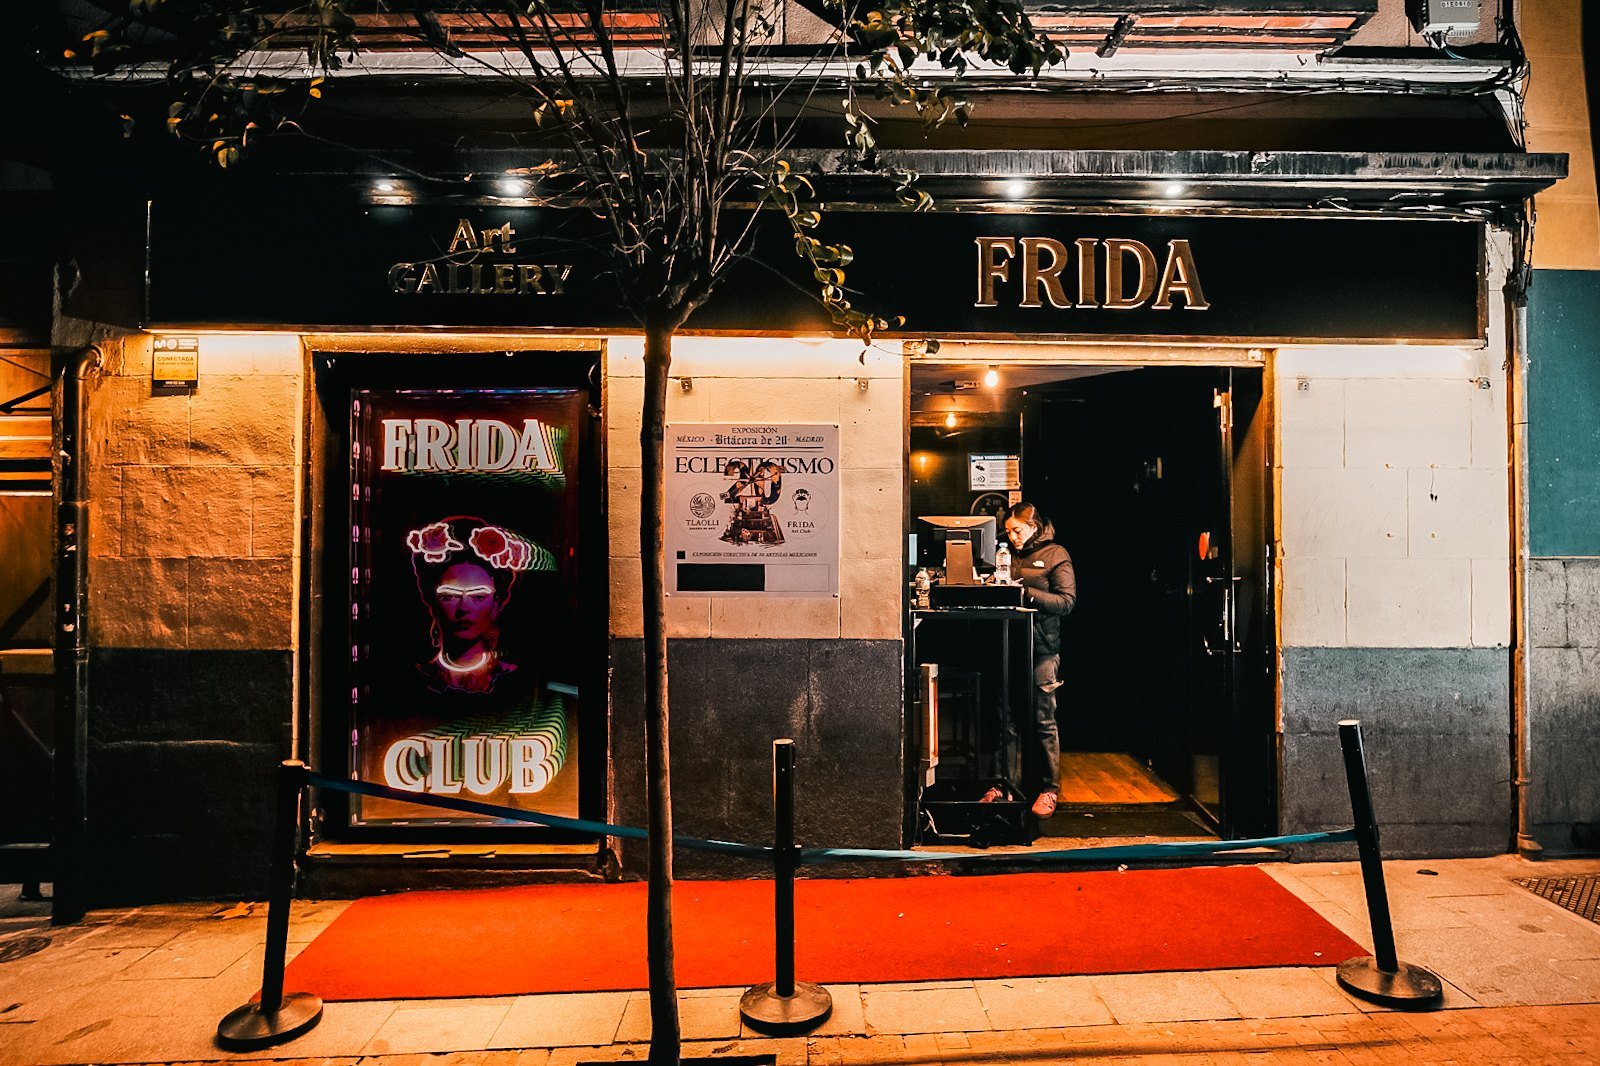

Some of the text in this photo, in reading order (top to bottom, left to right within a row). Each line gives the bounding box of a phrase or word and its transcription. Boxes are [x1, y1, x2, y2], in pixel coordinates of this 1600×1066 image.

[448, 218, 516, 254] Art
[387, 262, 573, 295] GALLERY
[974, 236, 1211, 310] FRIDA
[381, 419, 557, 472] FRIDA
[715, 434, 758, 445] Bitácora
[761, 434, 772, 445] de
[384, 738, 548, 796] CLUB
